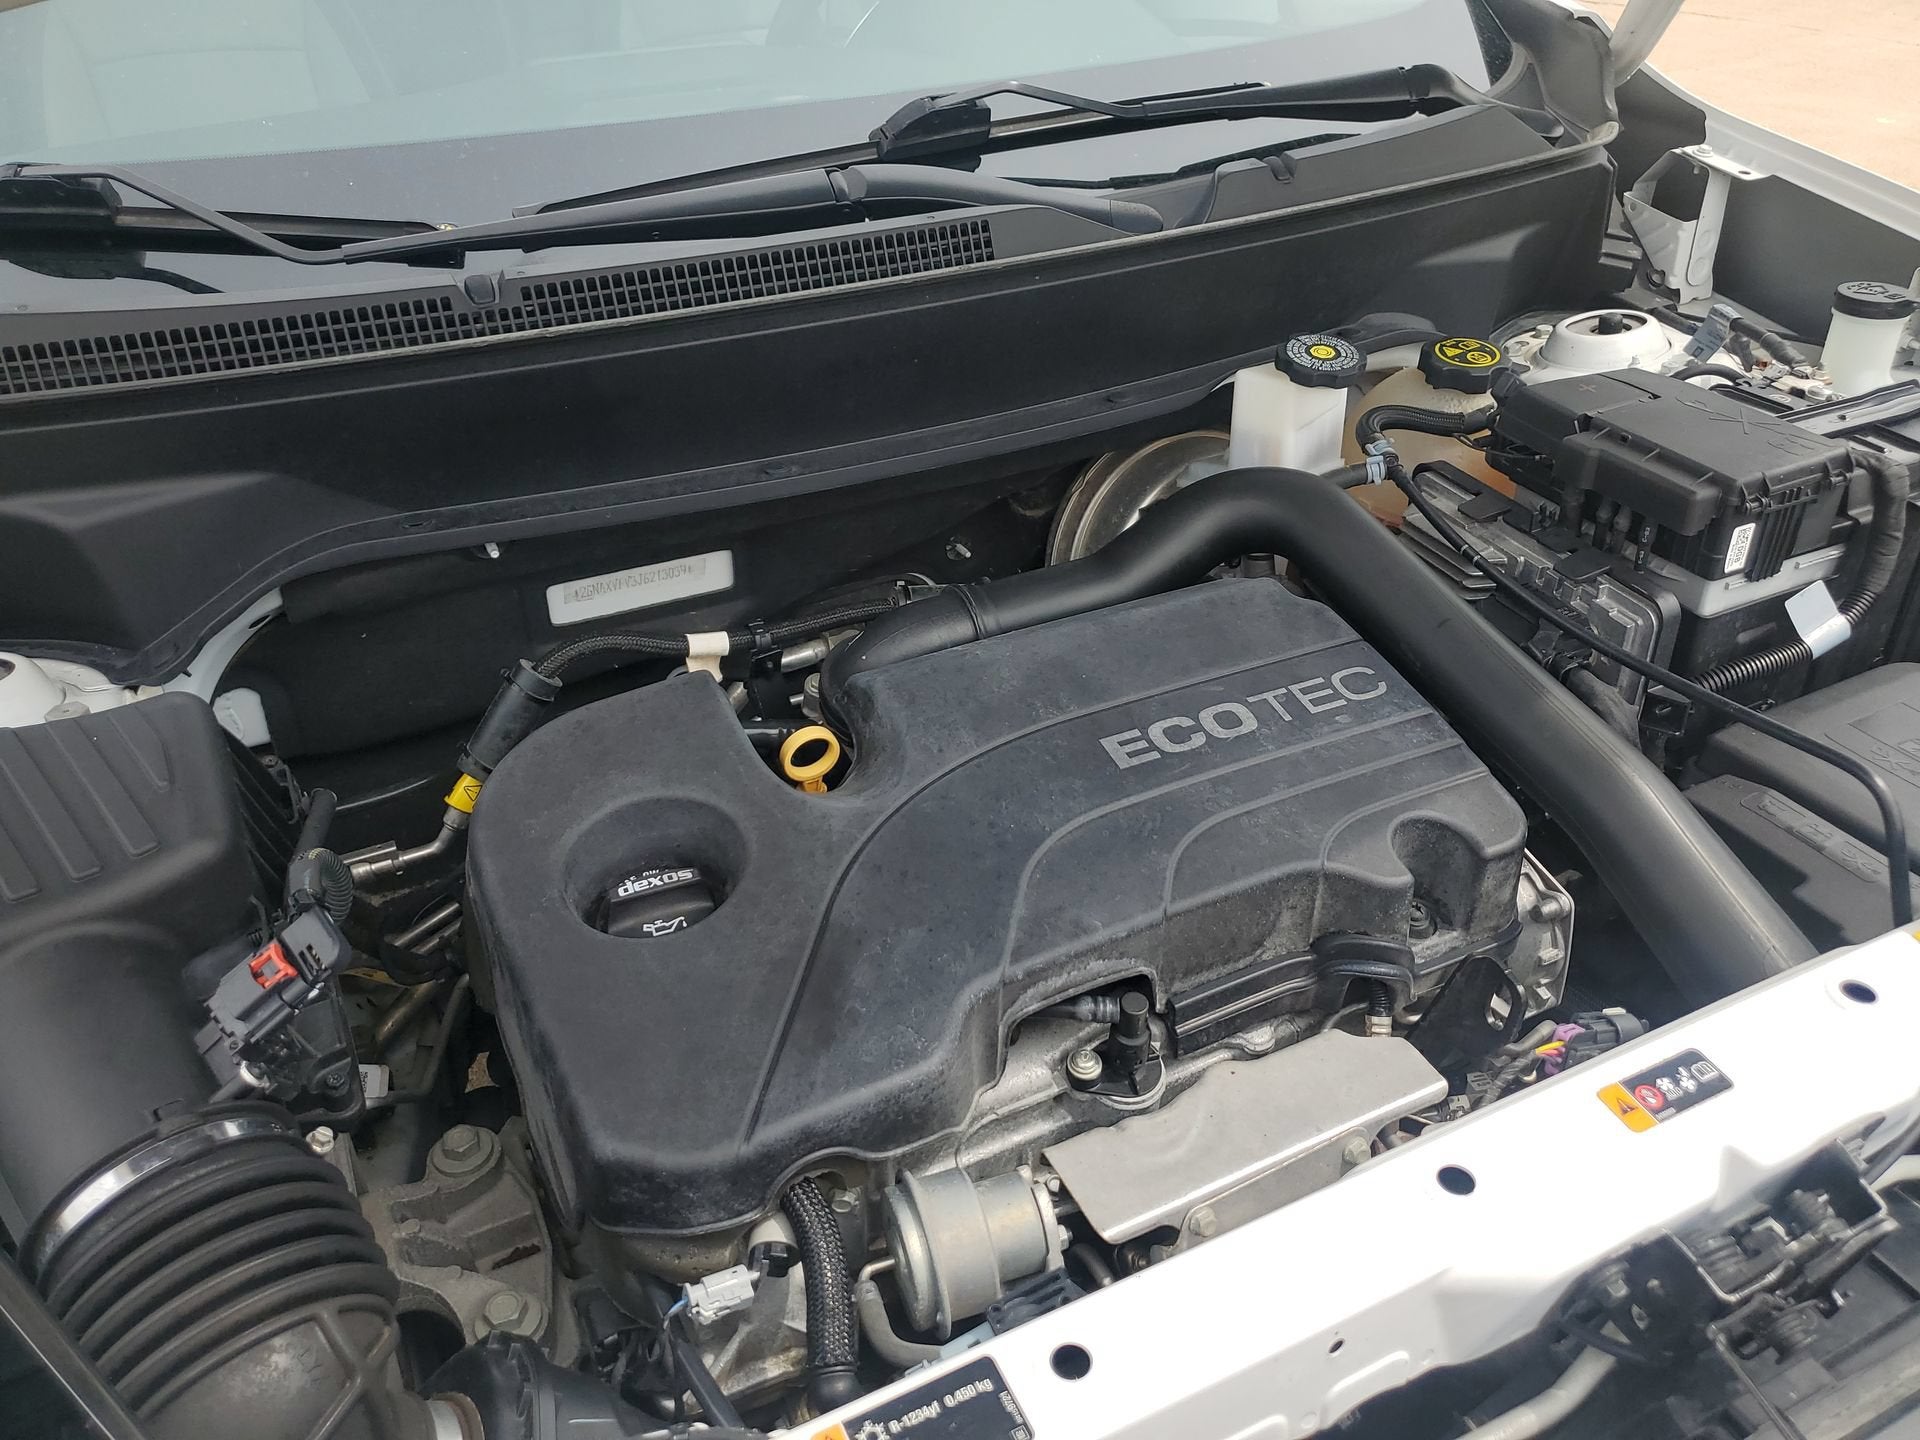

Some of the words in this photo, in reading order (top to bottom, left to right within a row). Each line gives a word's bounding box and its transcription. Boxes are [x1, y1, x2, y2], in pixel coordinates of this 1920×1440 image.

[1098, 666, 1388, 770] ECOTEC
[618, 869, 694, 897] dexos
[887, 1399, 941, 1433] R-1234yf
[974, 1378, 994, 1393] kg
